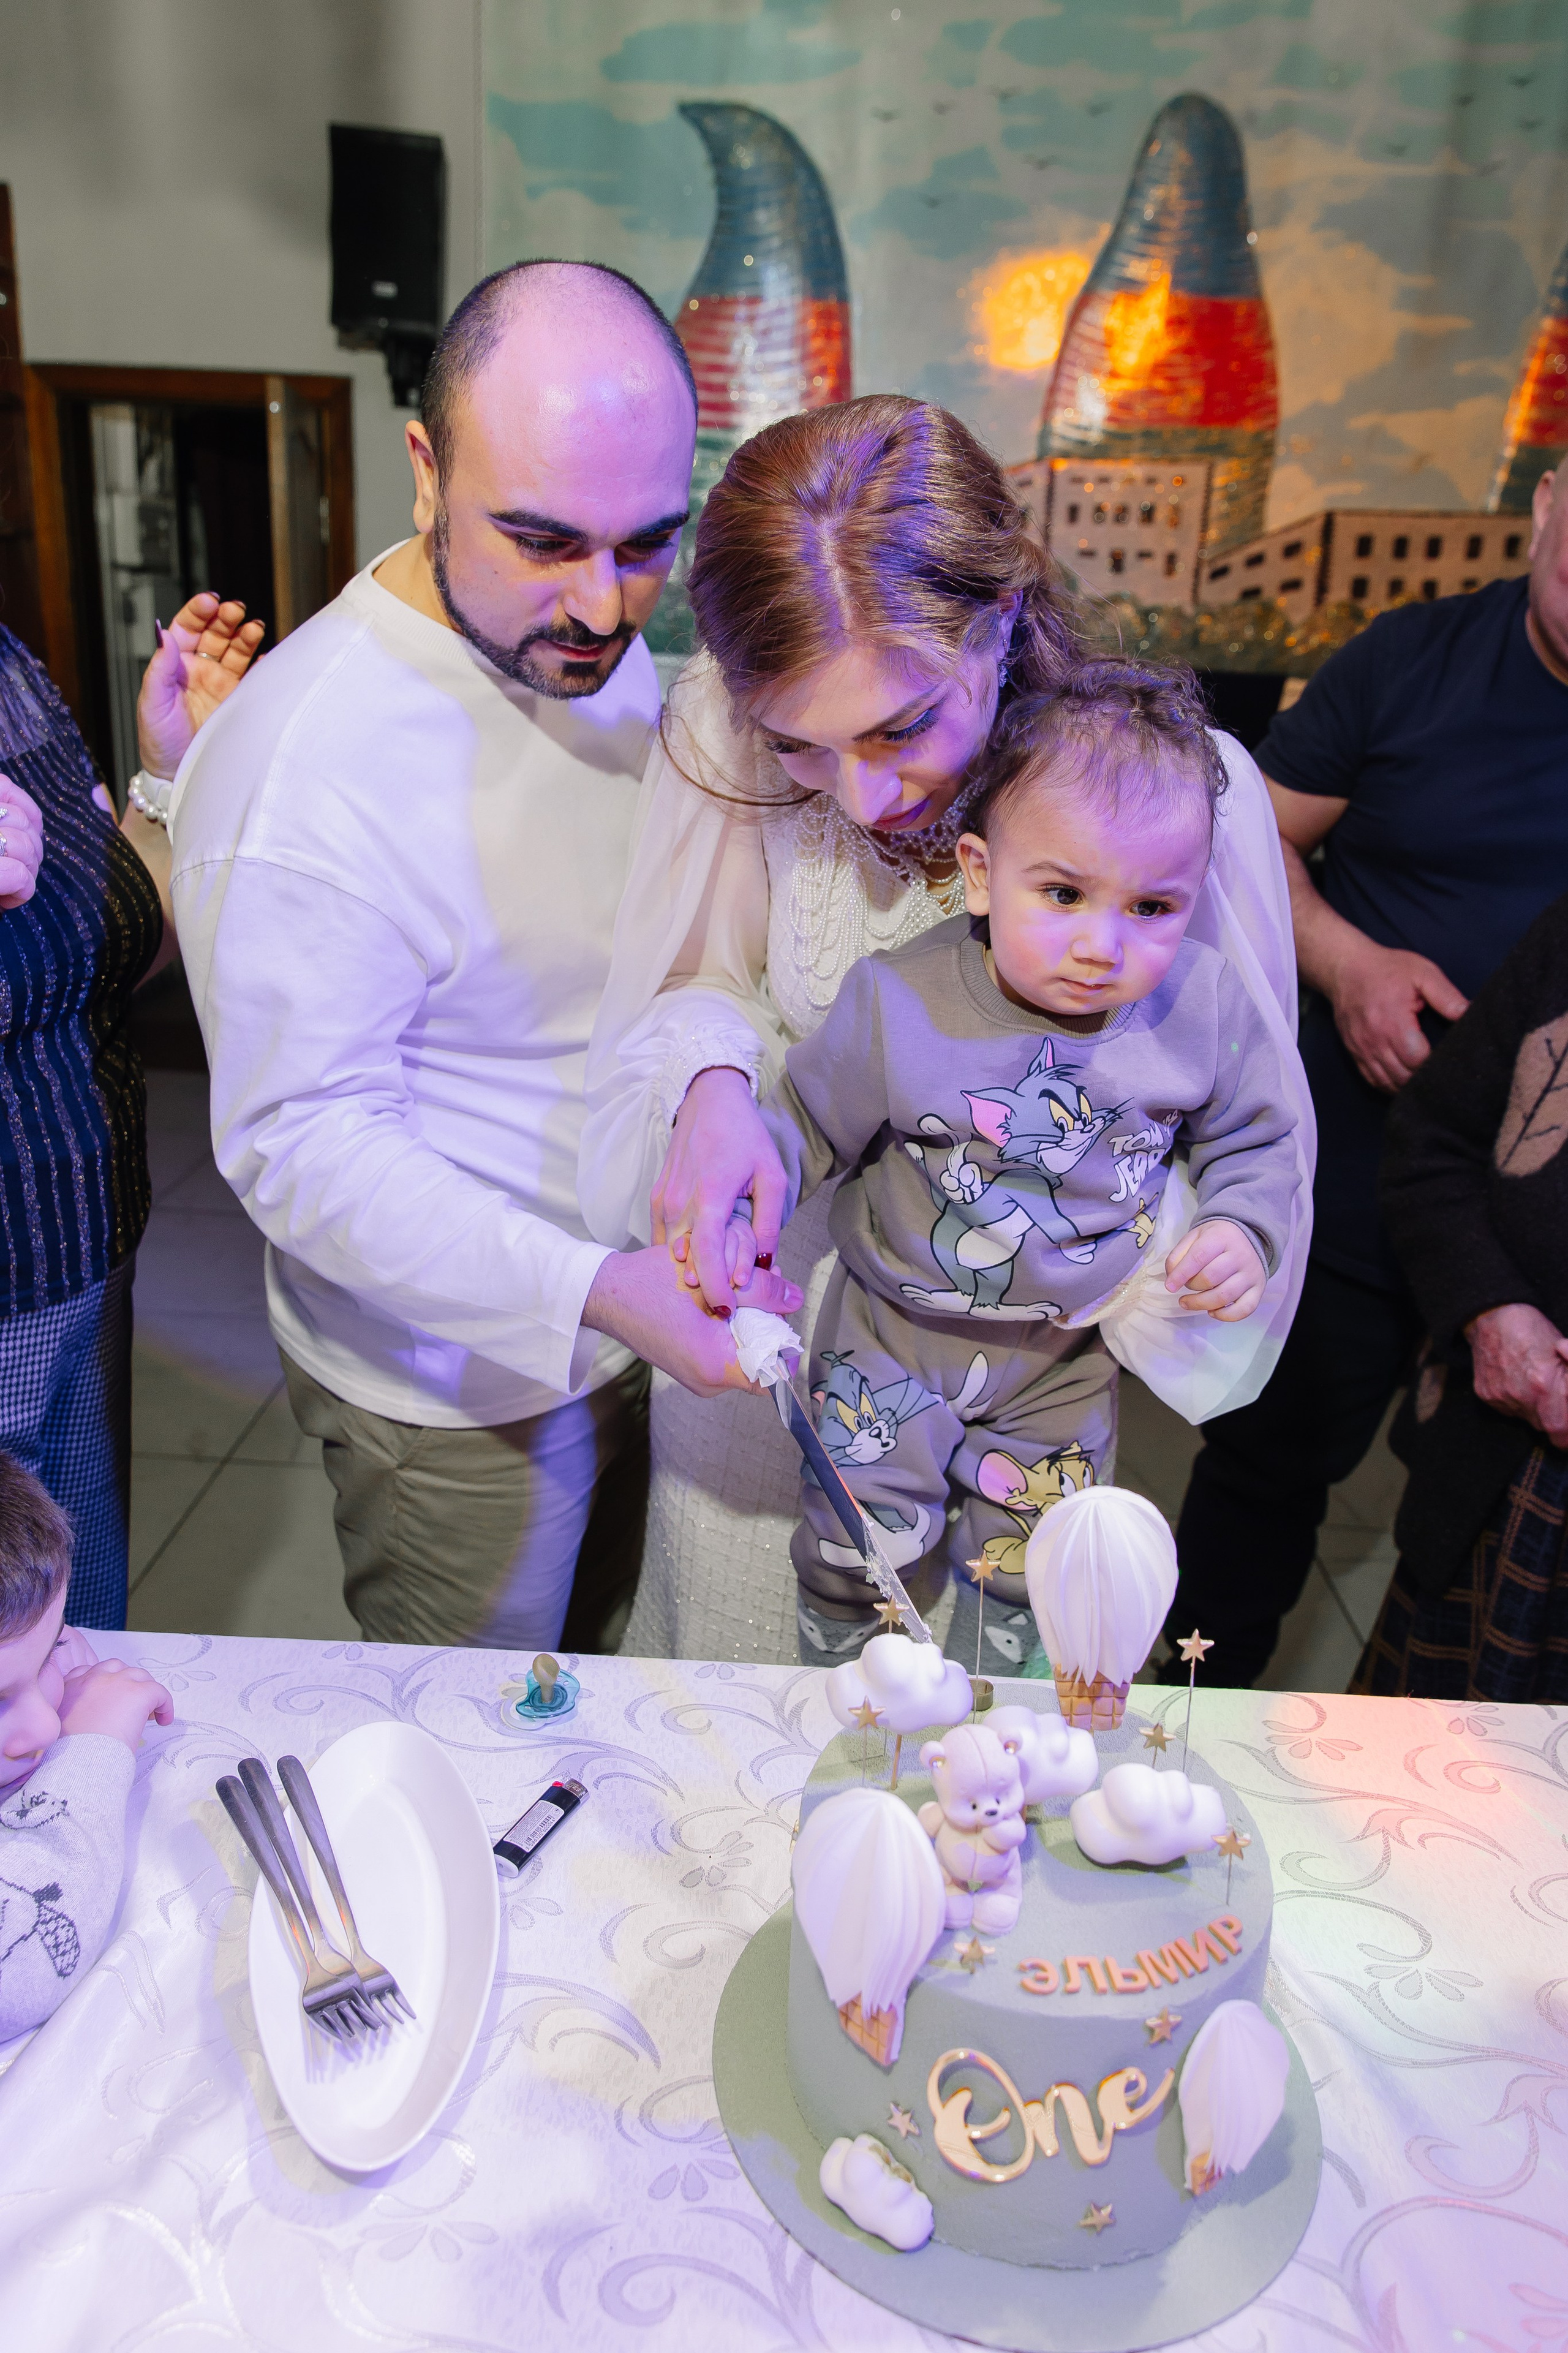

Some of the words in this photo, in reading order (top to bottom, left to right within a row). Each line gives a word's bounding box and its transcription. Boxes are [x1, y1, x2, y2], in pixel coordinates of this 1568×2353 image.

[1107, 1120, 1164, 1157] TOM
[1018, 1914, 1243, 1995] ЭЛЬМИР
[927, 2047, 1175, 2183] One
